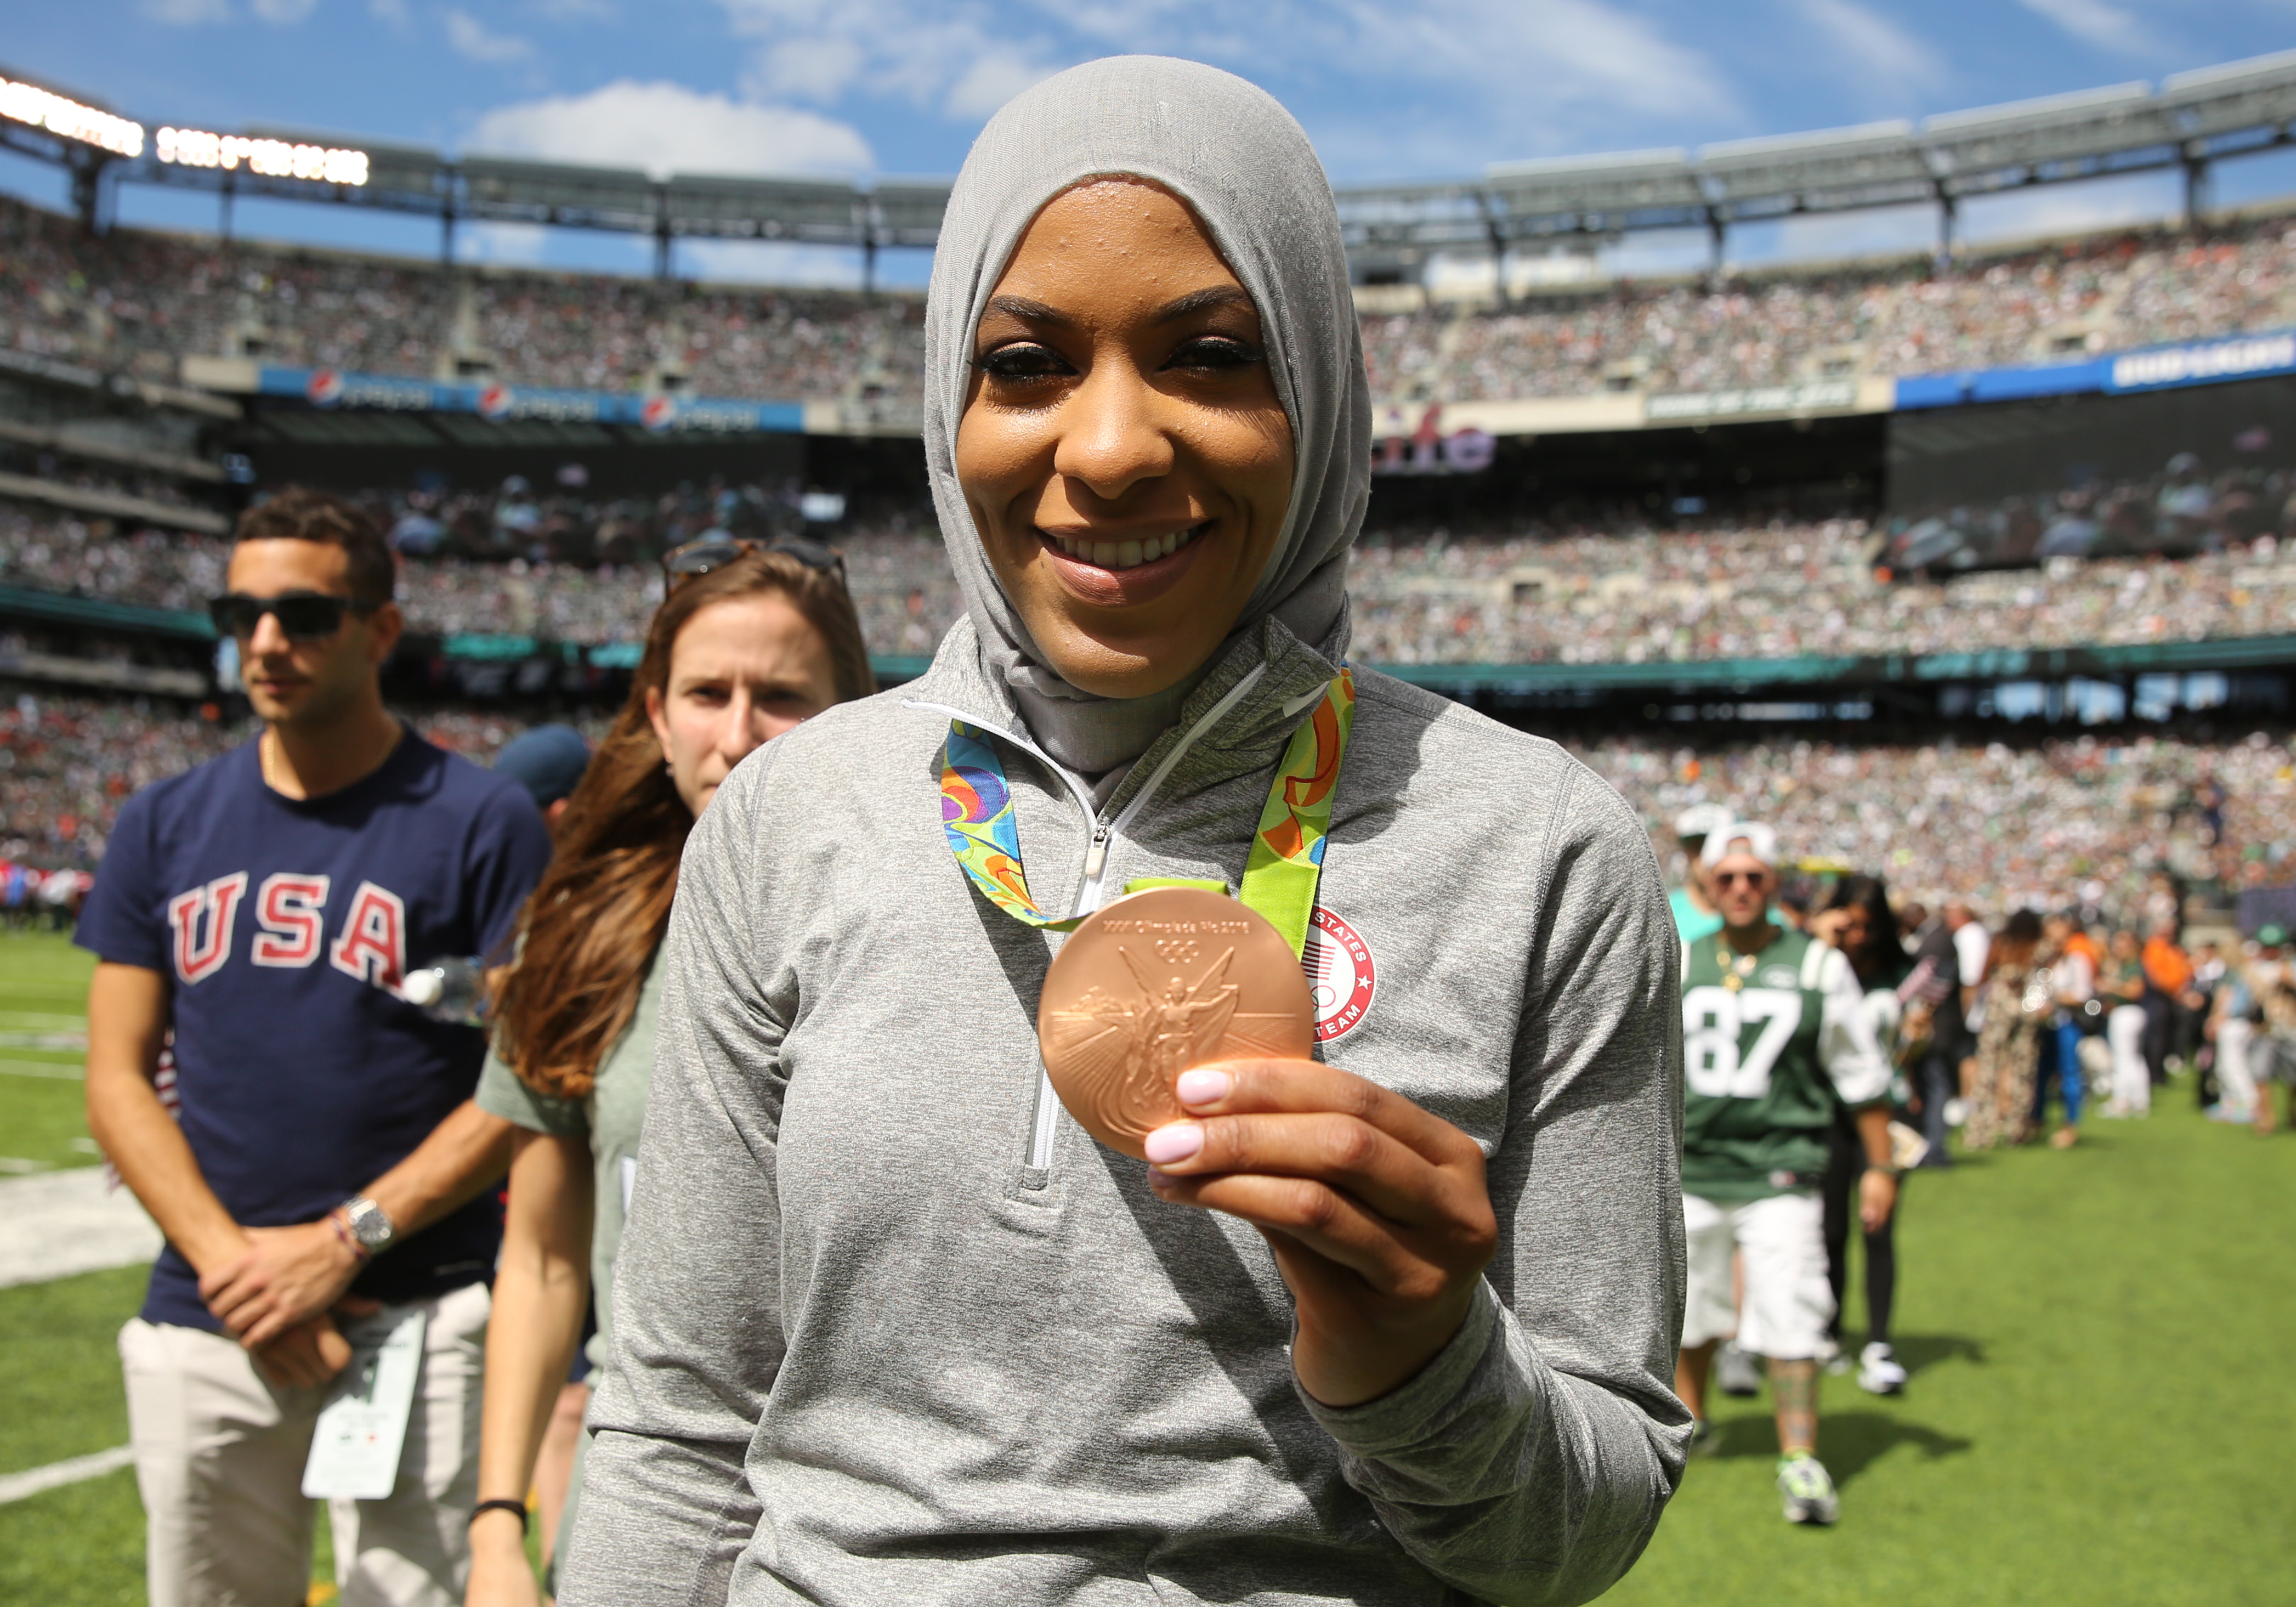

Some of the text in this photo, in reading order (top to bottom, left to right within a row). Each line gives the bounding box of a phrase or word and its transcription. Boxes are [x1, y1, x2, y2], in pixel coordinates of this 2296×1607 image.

[169, 870, 406, 1001] USA
[1314, 912, 1368, 962] STATES
[1313, 1004, 1361, 1037] TEAM
[1682, 985, 1803, 1099] 87
